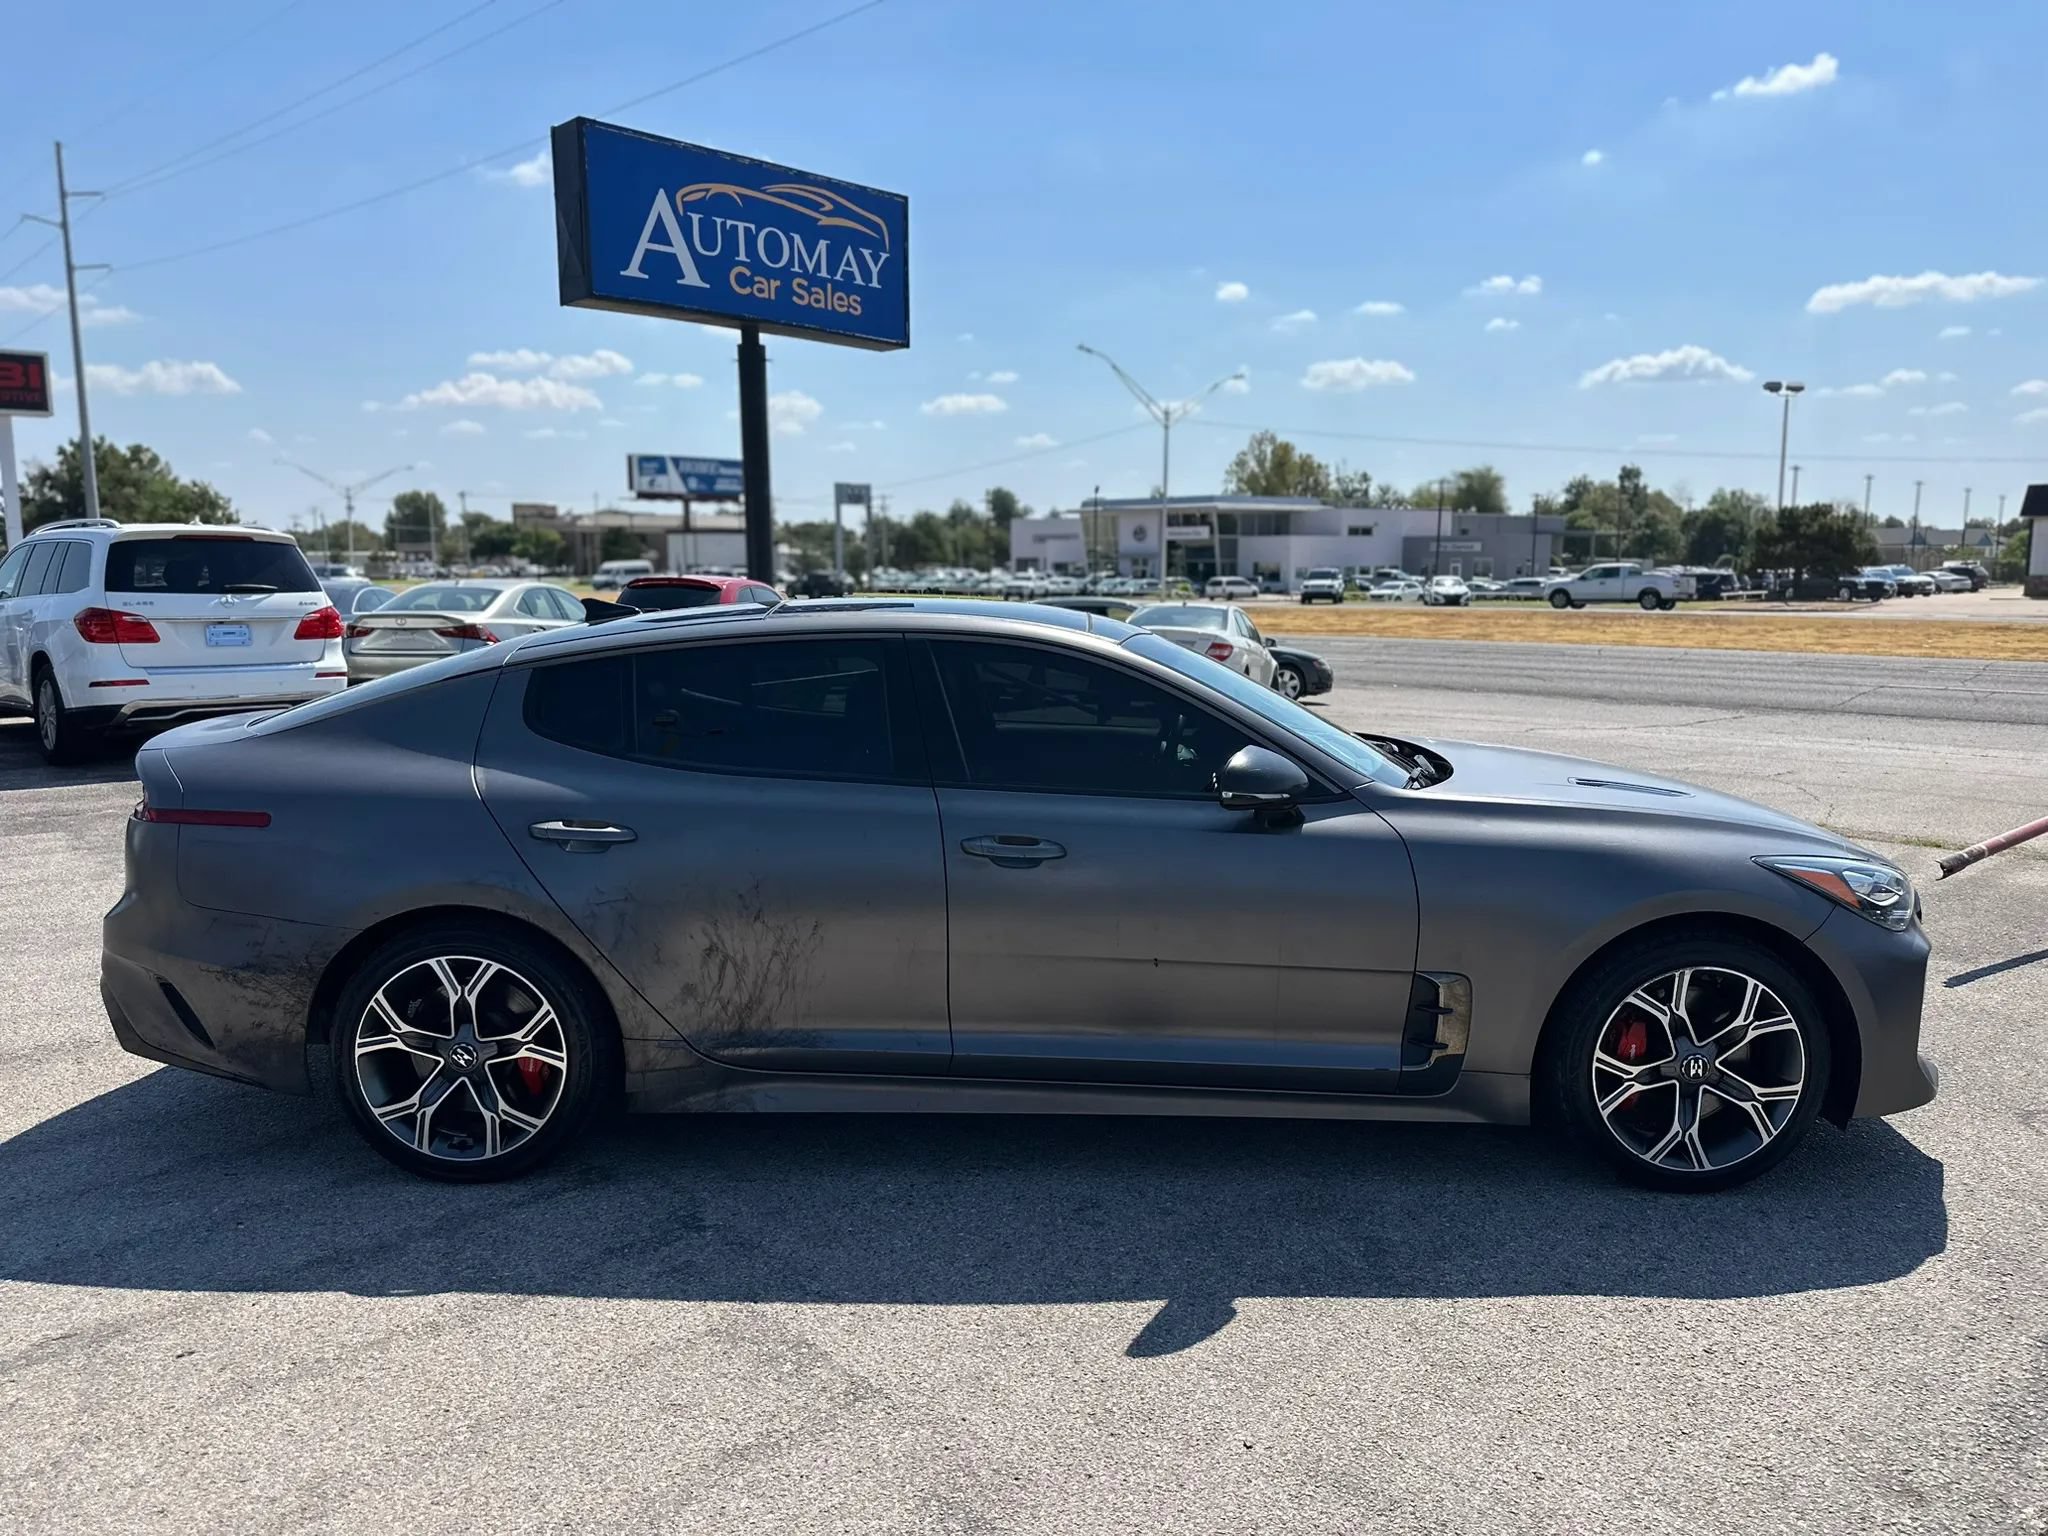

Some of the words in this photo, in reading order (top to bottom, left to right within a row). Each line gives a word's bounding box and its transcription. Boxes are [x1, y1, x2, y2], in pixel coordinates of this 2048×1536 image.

[619, 187, 890, 289] AUTOMAY
[729, 265, 781, 300] Car
[792, 278, 862, 316] Sales
